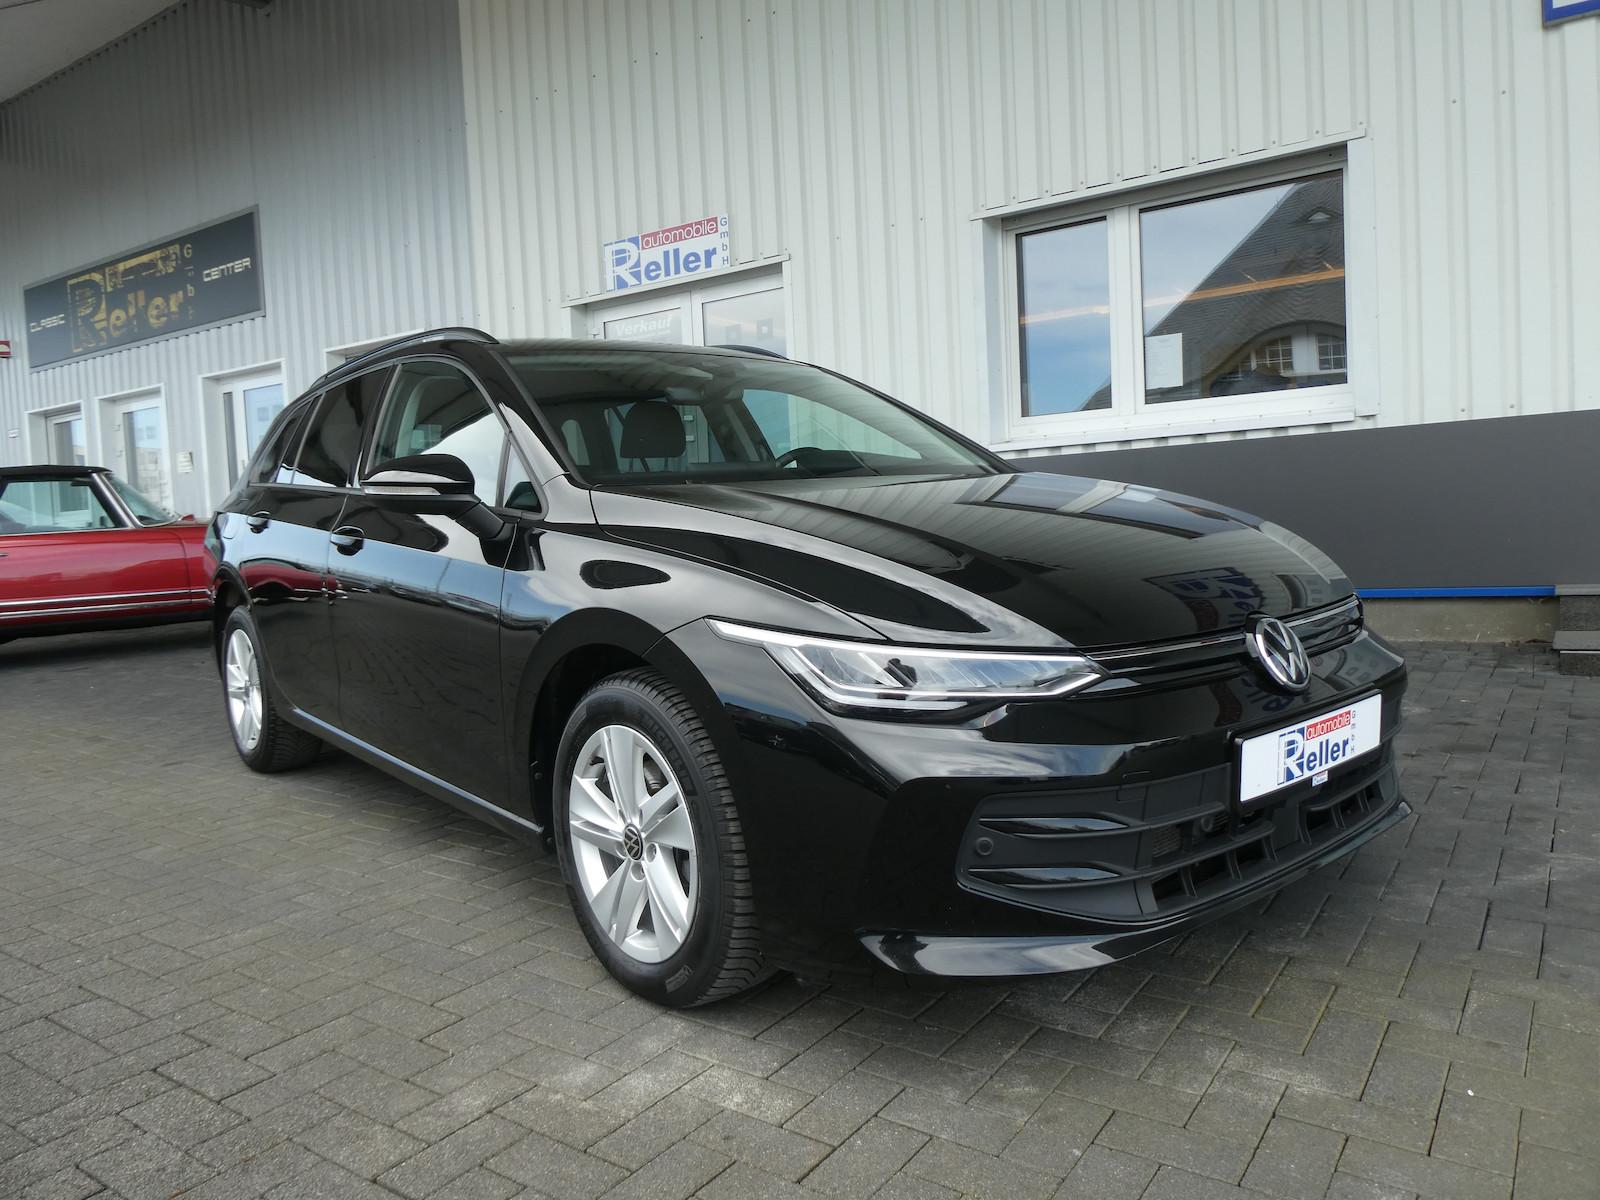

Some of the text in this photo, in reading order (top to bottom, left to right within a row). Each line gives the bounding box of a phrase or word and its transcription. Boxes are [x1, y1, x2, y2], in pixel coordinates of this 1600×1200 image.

[642, 220, 717, 250] automobile
[203, 257, 251, 282] CENTER
[604, 237, 718, 292] Reller
[615, 314, 672, 337] Verkauf
[1307, 713, 1351, 740] automobile
[1278, 729, 1349, 786] Reller
